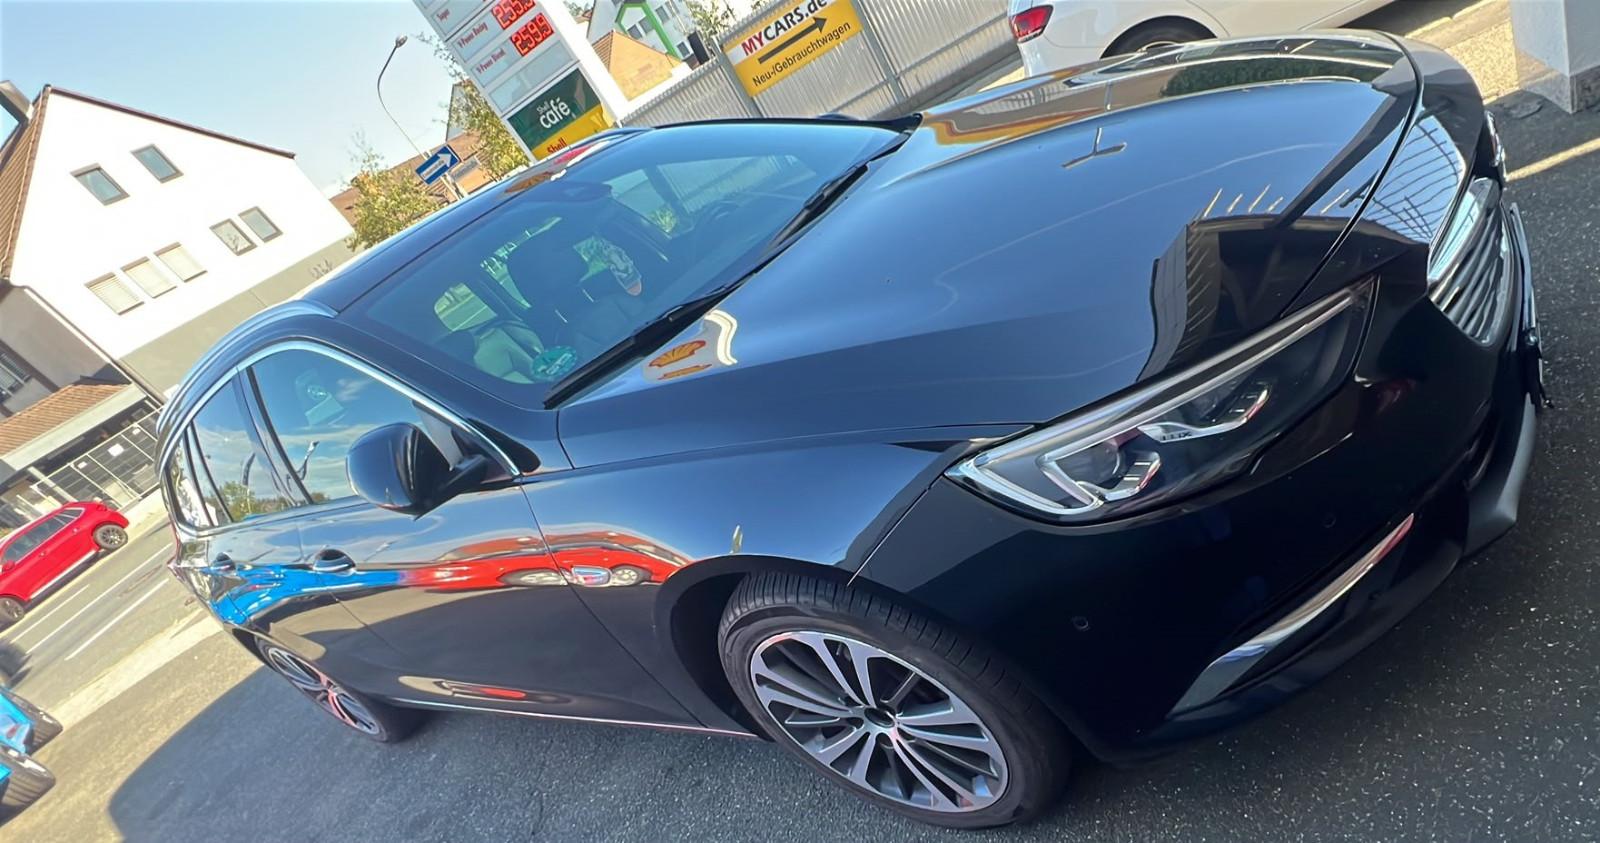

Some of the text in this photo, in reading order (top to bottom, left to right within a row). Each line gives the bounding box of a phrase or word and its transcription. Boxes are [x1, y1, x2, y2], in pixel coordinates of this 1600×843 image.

[511, 14, 552, 54] 259.9
[741, 0, 827, 56] MYCARS.de
[752, 22, 851, 87] Neu-/Gebrauchtwagen
[536, 101, 550, 115] Shell
[540, 97, 570, 128] café
